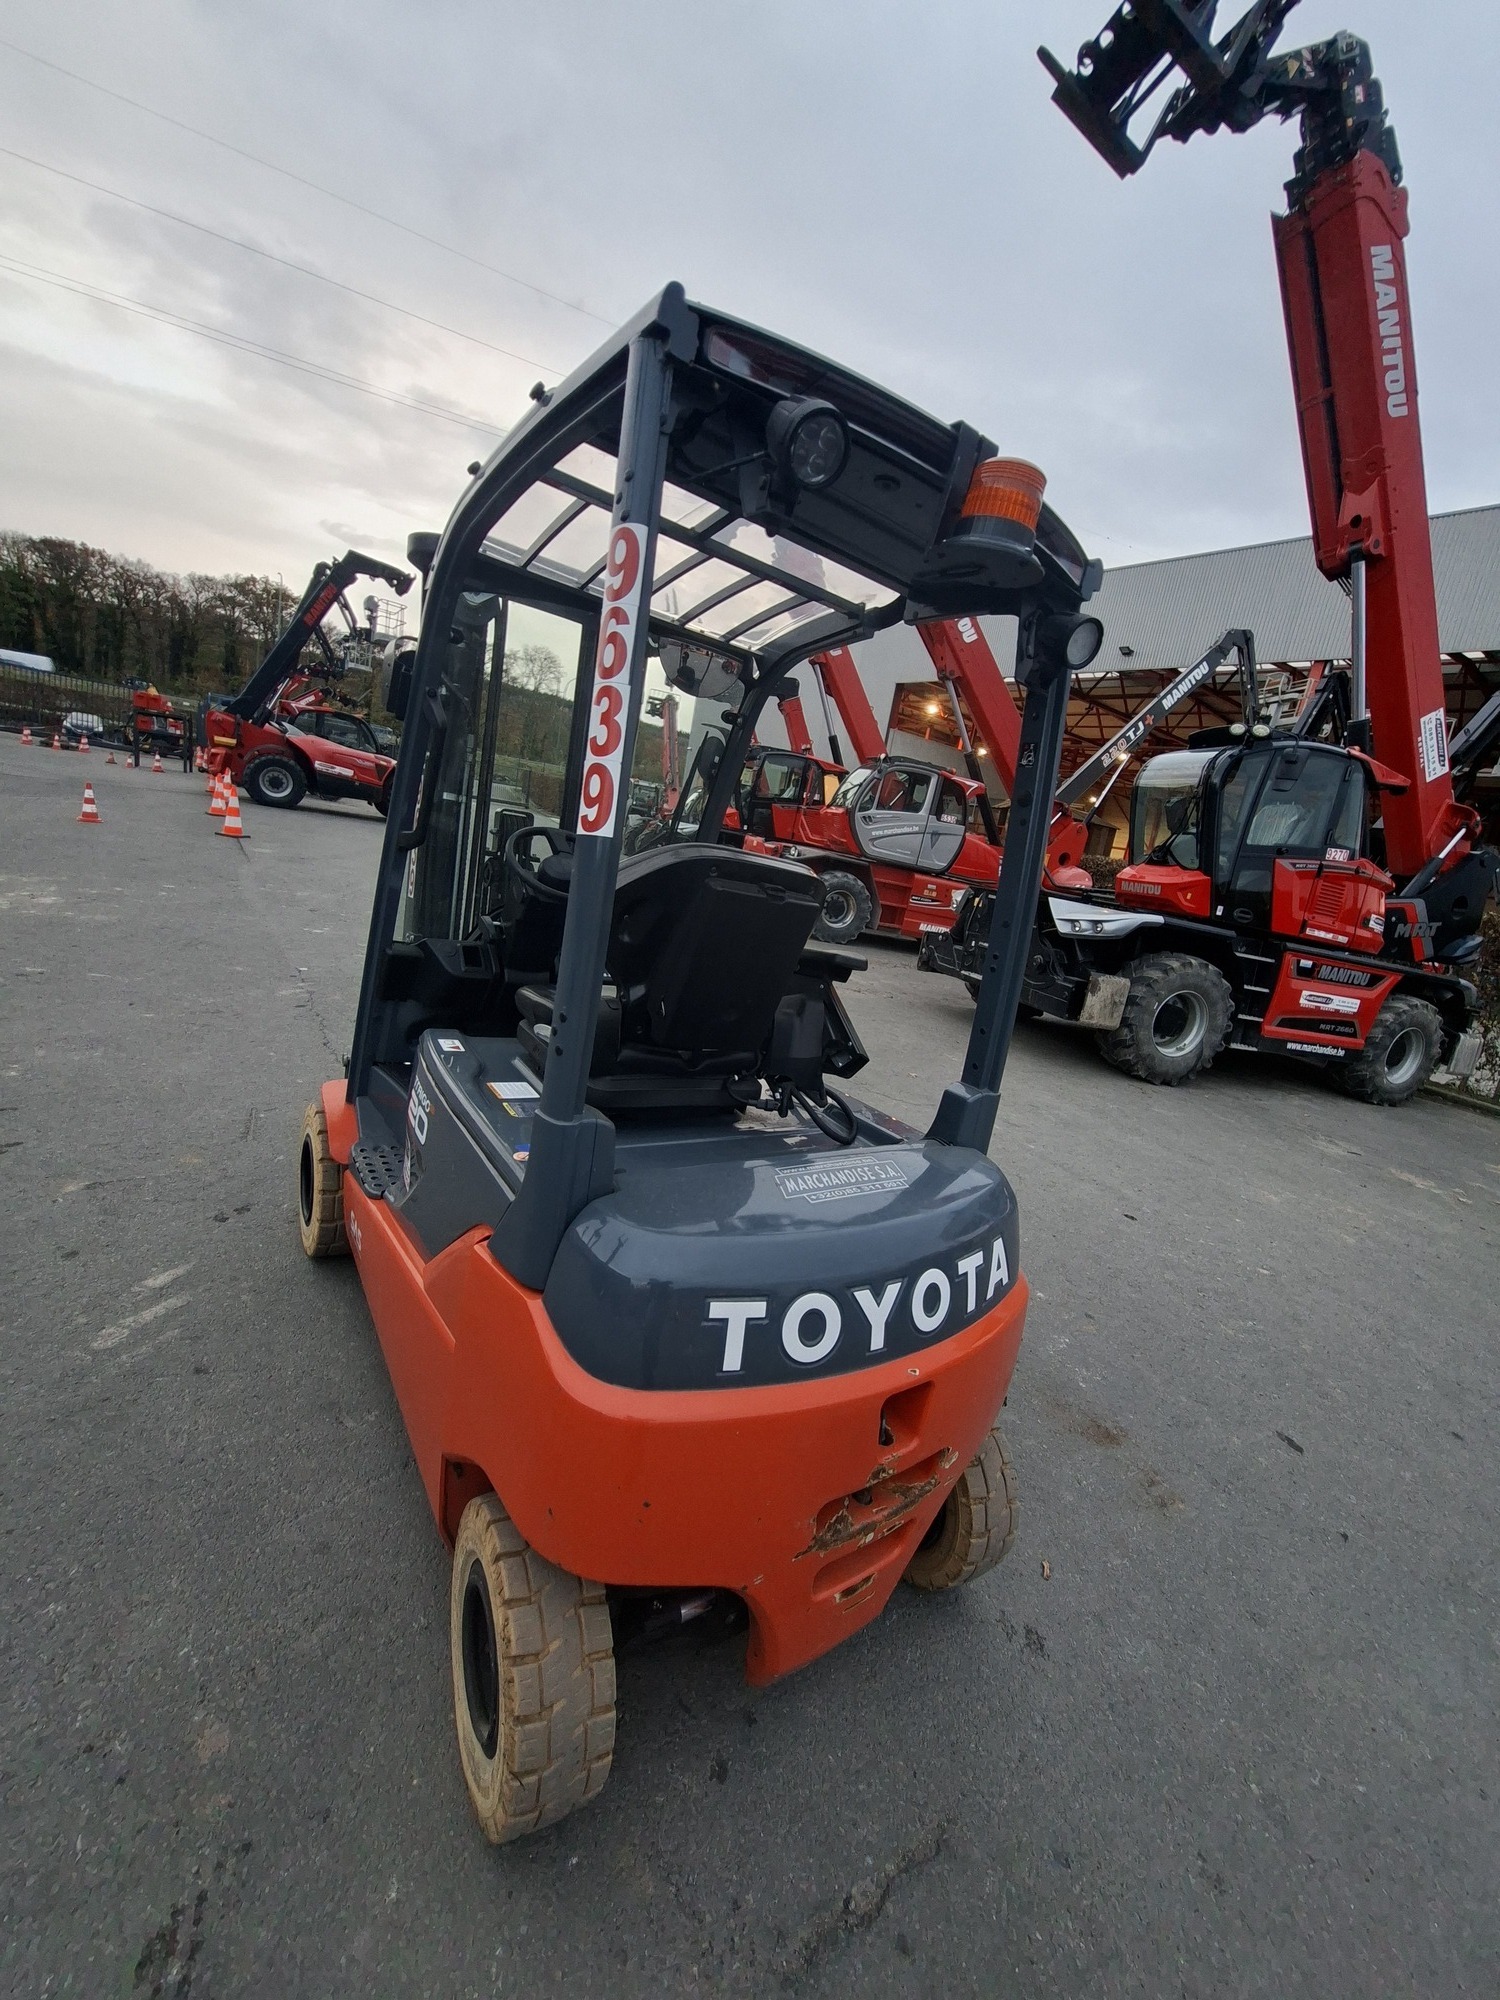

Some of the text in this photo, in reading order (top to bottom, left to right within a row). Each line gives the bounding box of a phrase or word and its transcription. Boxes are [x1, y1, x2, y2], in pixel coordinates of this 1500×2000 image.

[1370, 244, 1409, 418] MANITOU
[580, 526, 640, 833] 9639
[1161, 661, 1210, 710] MANITOU
[1327, 849, 1349, 861] 9270
[1121, 880, 1162, 895] MANITOU
[1394, 922, 1442, 938] MRT
[1318, 965, 1371, 986] MANITOU
[1319, 1023, 1335, 1031] MRT
[1286, 1042, 1346, 1057] www.marchandise.be
[408, 1088, 428, 1145] 20
[784, 1164, 901, 1193] MARCHANDISE S.A.
[863, 1184, 882, 1193] 311
[708, 1236, 1009, 1371] TOYOTA
